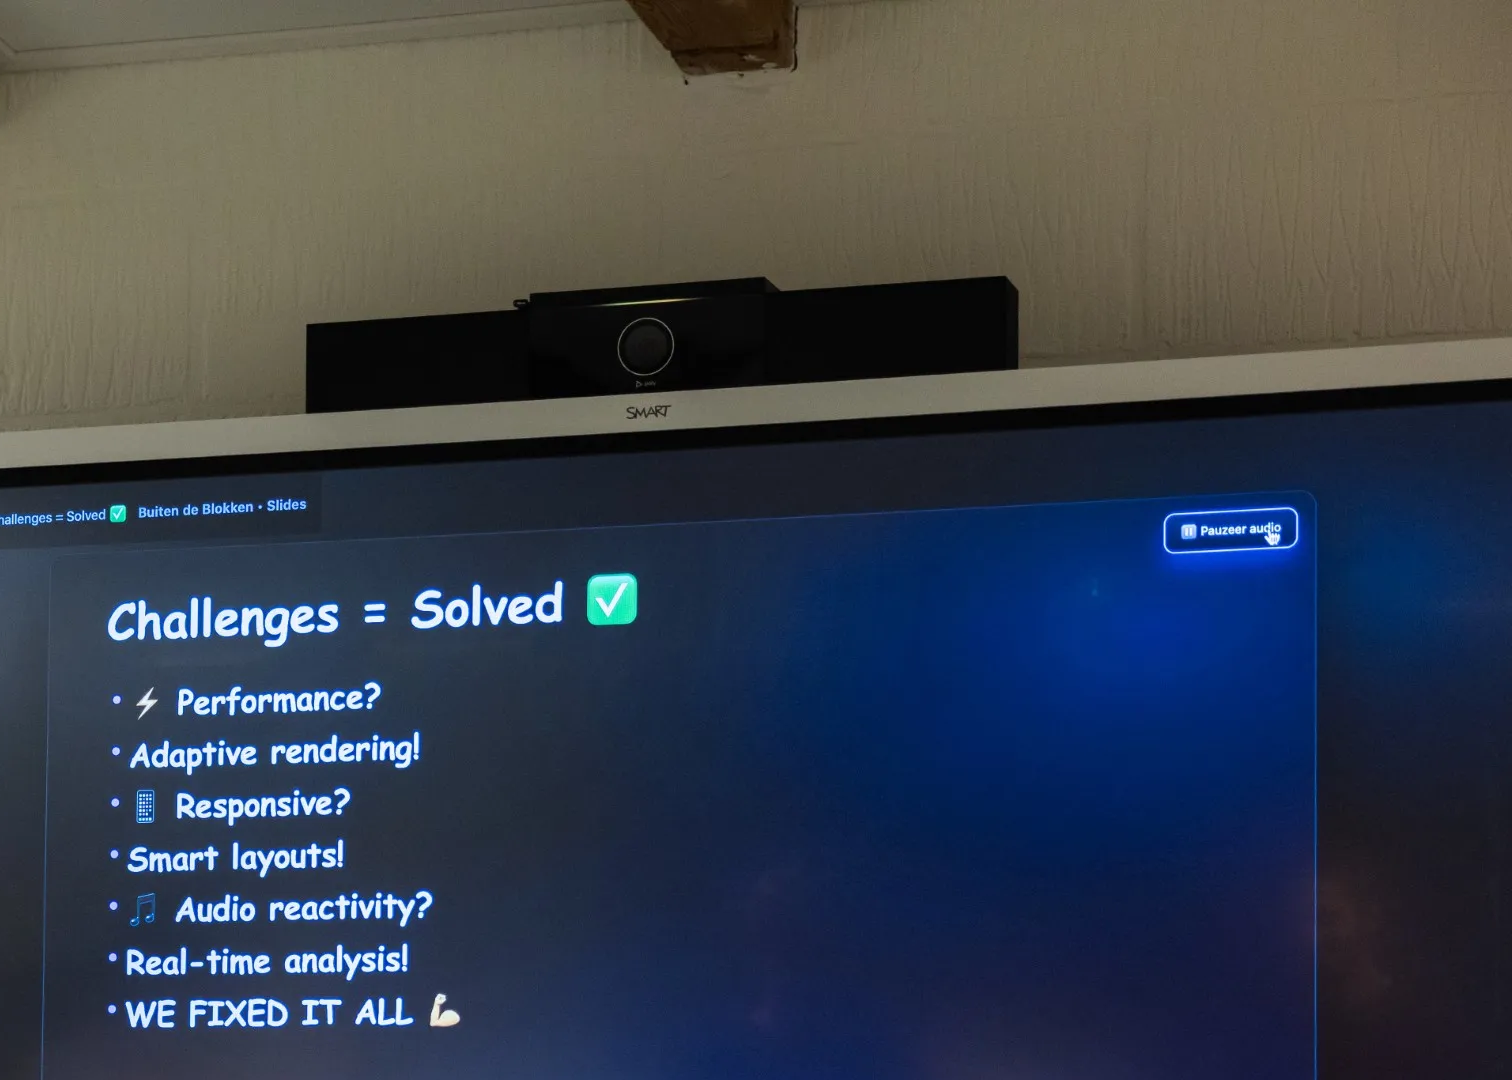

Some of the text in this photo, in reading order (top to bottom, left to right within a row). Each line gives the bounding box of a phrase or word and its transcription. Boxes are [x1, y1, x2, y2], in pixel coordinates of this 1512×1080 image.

[626, 405, 671, 419] SMART
[67, 509, 105, 521] Solved
[139, 499, 306, 518] Buiten de Blokken Slides
[1201, 522, 1281, 536] Pauzeer audio
[108, 581, 562, 647] Challenges = Solved
[178, 682, 381, 715] Performance?
[130, 732, 419, 775] Adaptive rendering!
[177, 788, 350, 826] Responsive?
[128, 840, 343, 877] Smart layouts!
[176, 891, 432, 927] Audio reactivity?
[127, 944, 407, 980] Real-time analysis!
[126, 998, 413, 1028] WE FIXED IT ALL
